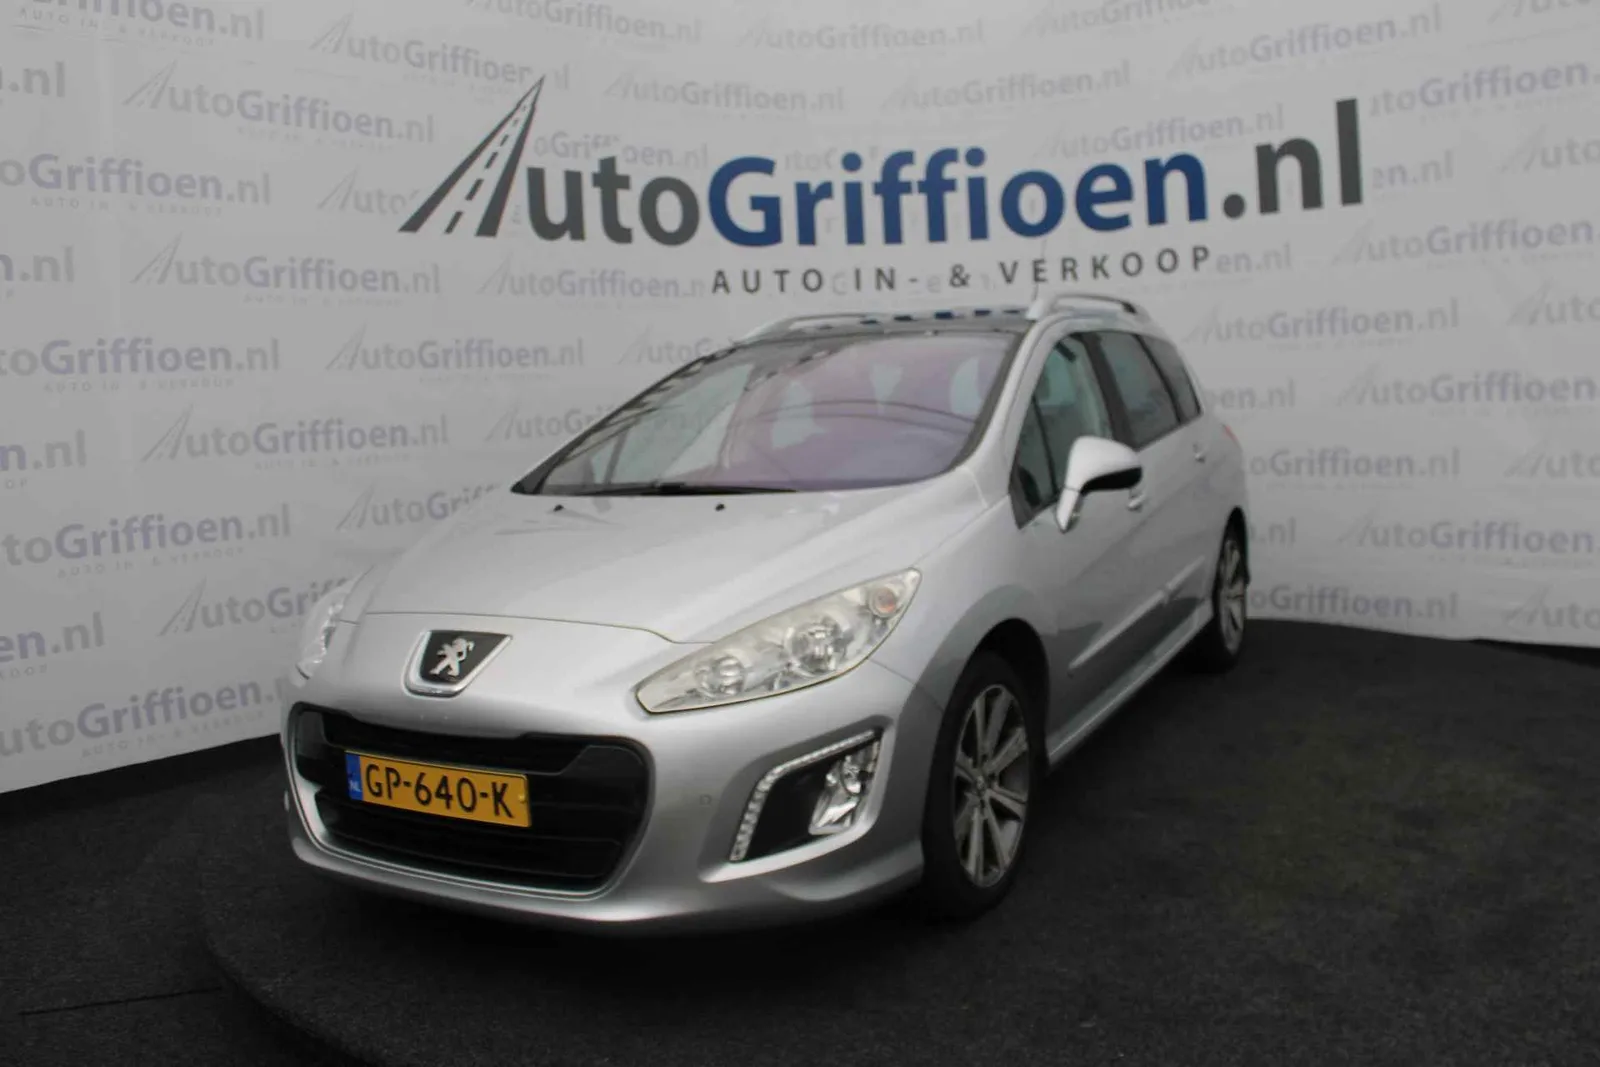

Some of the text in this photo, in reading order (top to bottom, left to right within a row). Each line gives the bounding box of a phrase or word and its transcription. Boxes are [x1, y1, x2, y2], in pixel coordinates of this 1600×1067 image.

[0, 60, 66, 98] .nl
[121, 58, 434, 143] AutoGriffioen.nl
[397, 74, 1364, 247] AutoGriffioen.nl
[129, 231, 440, 294] AutoGriffioen.nl
[711, 268, 824, 294] AUTO
[948, 263, 971, 288] &
[997, 244, 1210, 285] VERKOOP
[1331, 218, 1600, 266] AutoGriffioen
[325, 318, 585, 371] AutoGriffioen.nl
[139, 403, 449, 463] AutoGriffioen.nl
[365, 764, 514, 819] GP-640-K
